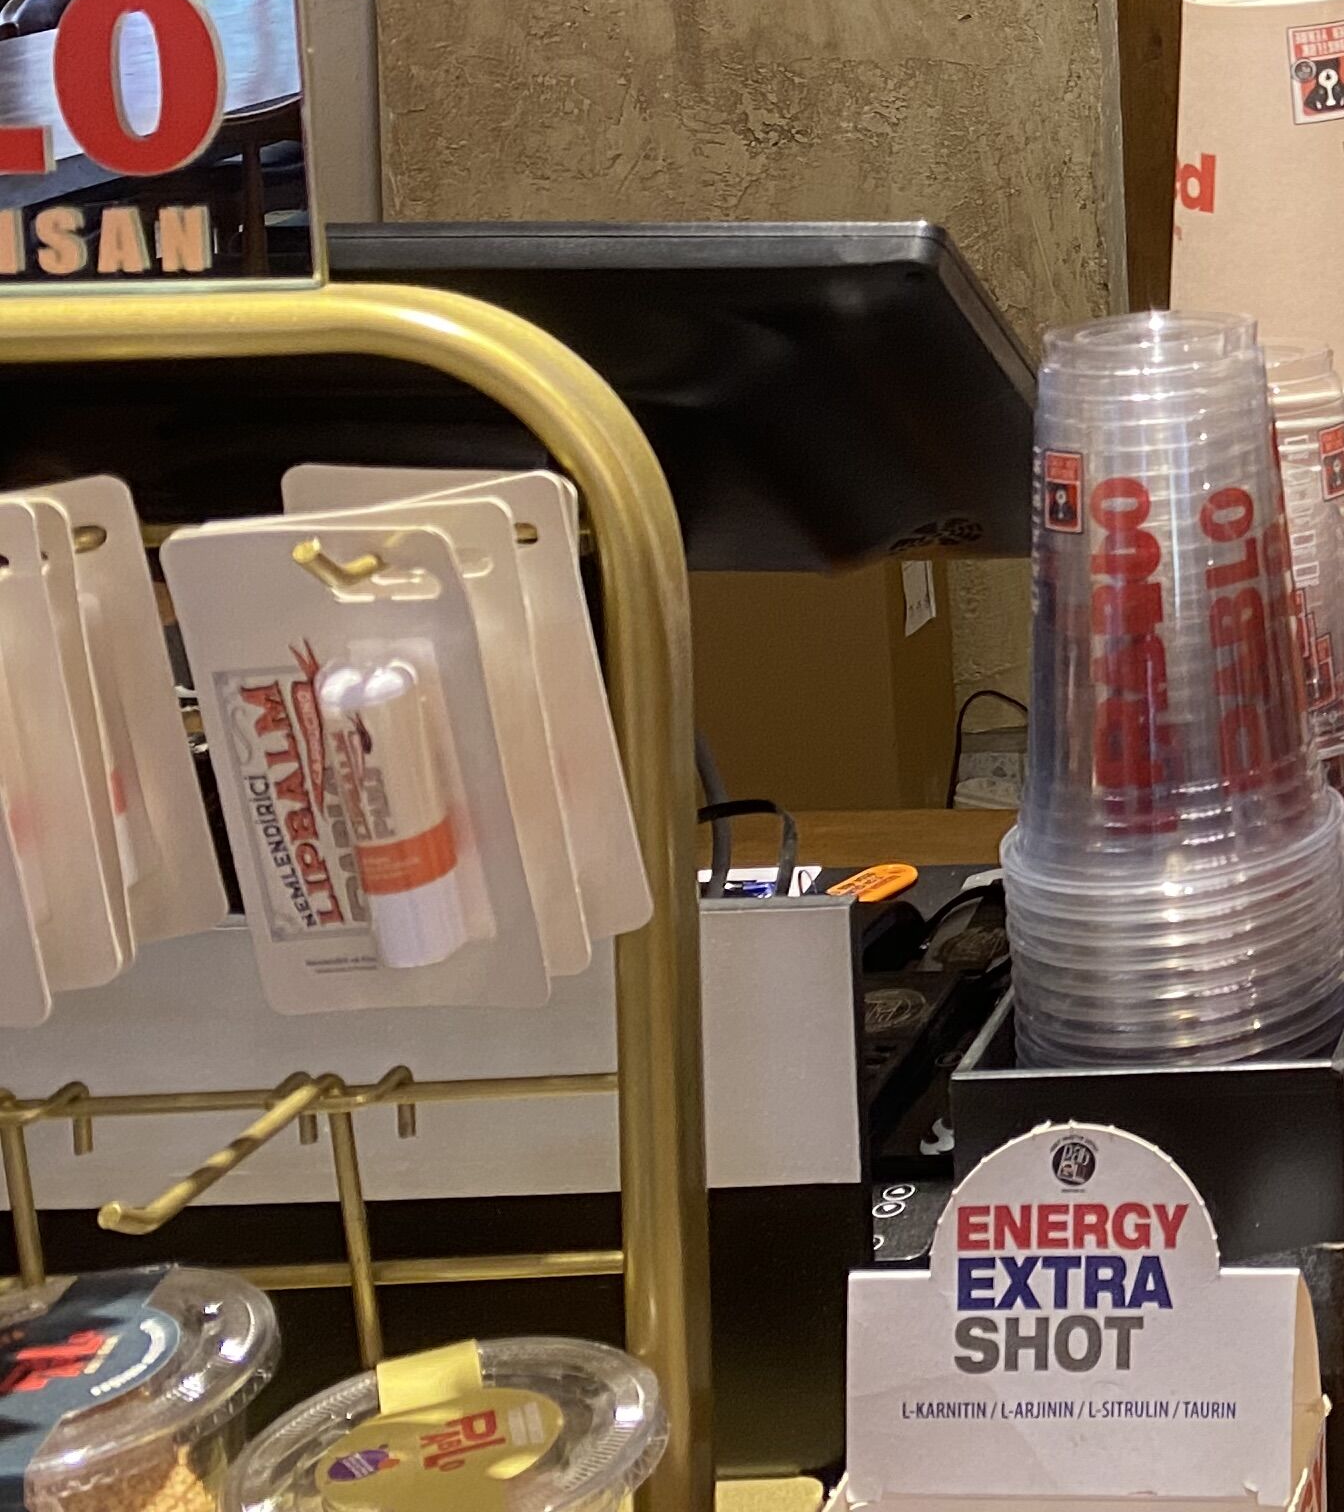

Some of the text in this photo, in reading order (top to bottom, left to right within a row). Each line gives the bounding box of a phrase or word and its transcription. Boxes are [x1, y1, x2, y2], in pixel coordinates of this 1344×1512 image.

[957, 1203, 1190, 1251] ENERGY
[957, 1256, 1173, 1311] EXTRA
[954, 1315, 1144, 1374] SHOT
[902, 1401, 1236, 1420] L-KARNITIN L-ARJININ L-SITRULIN TAURIN
